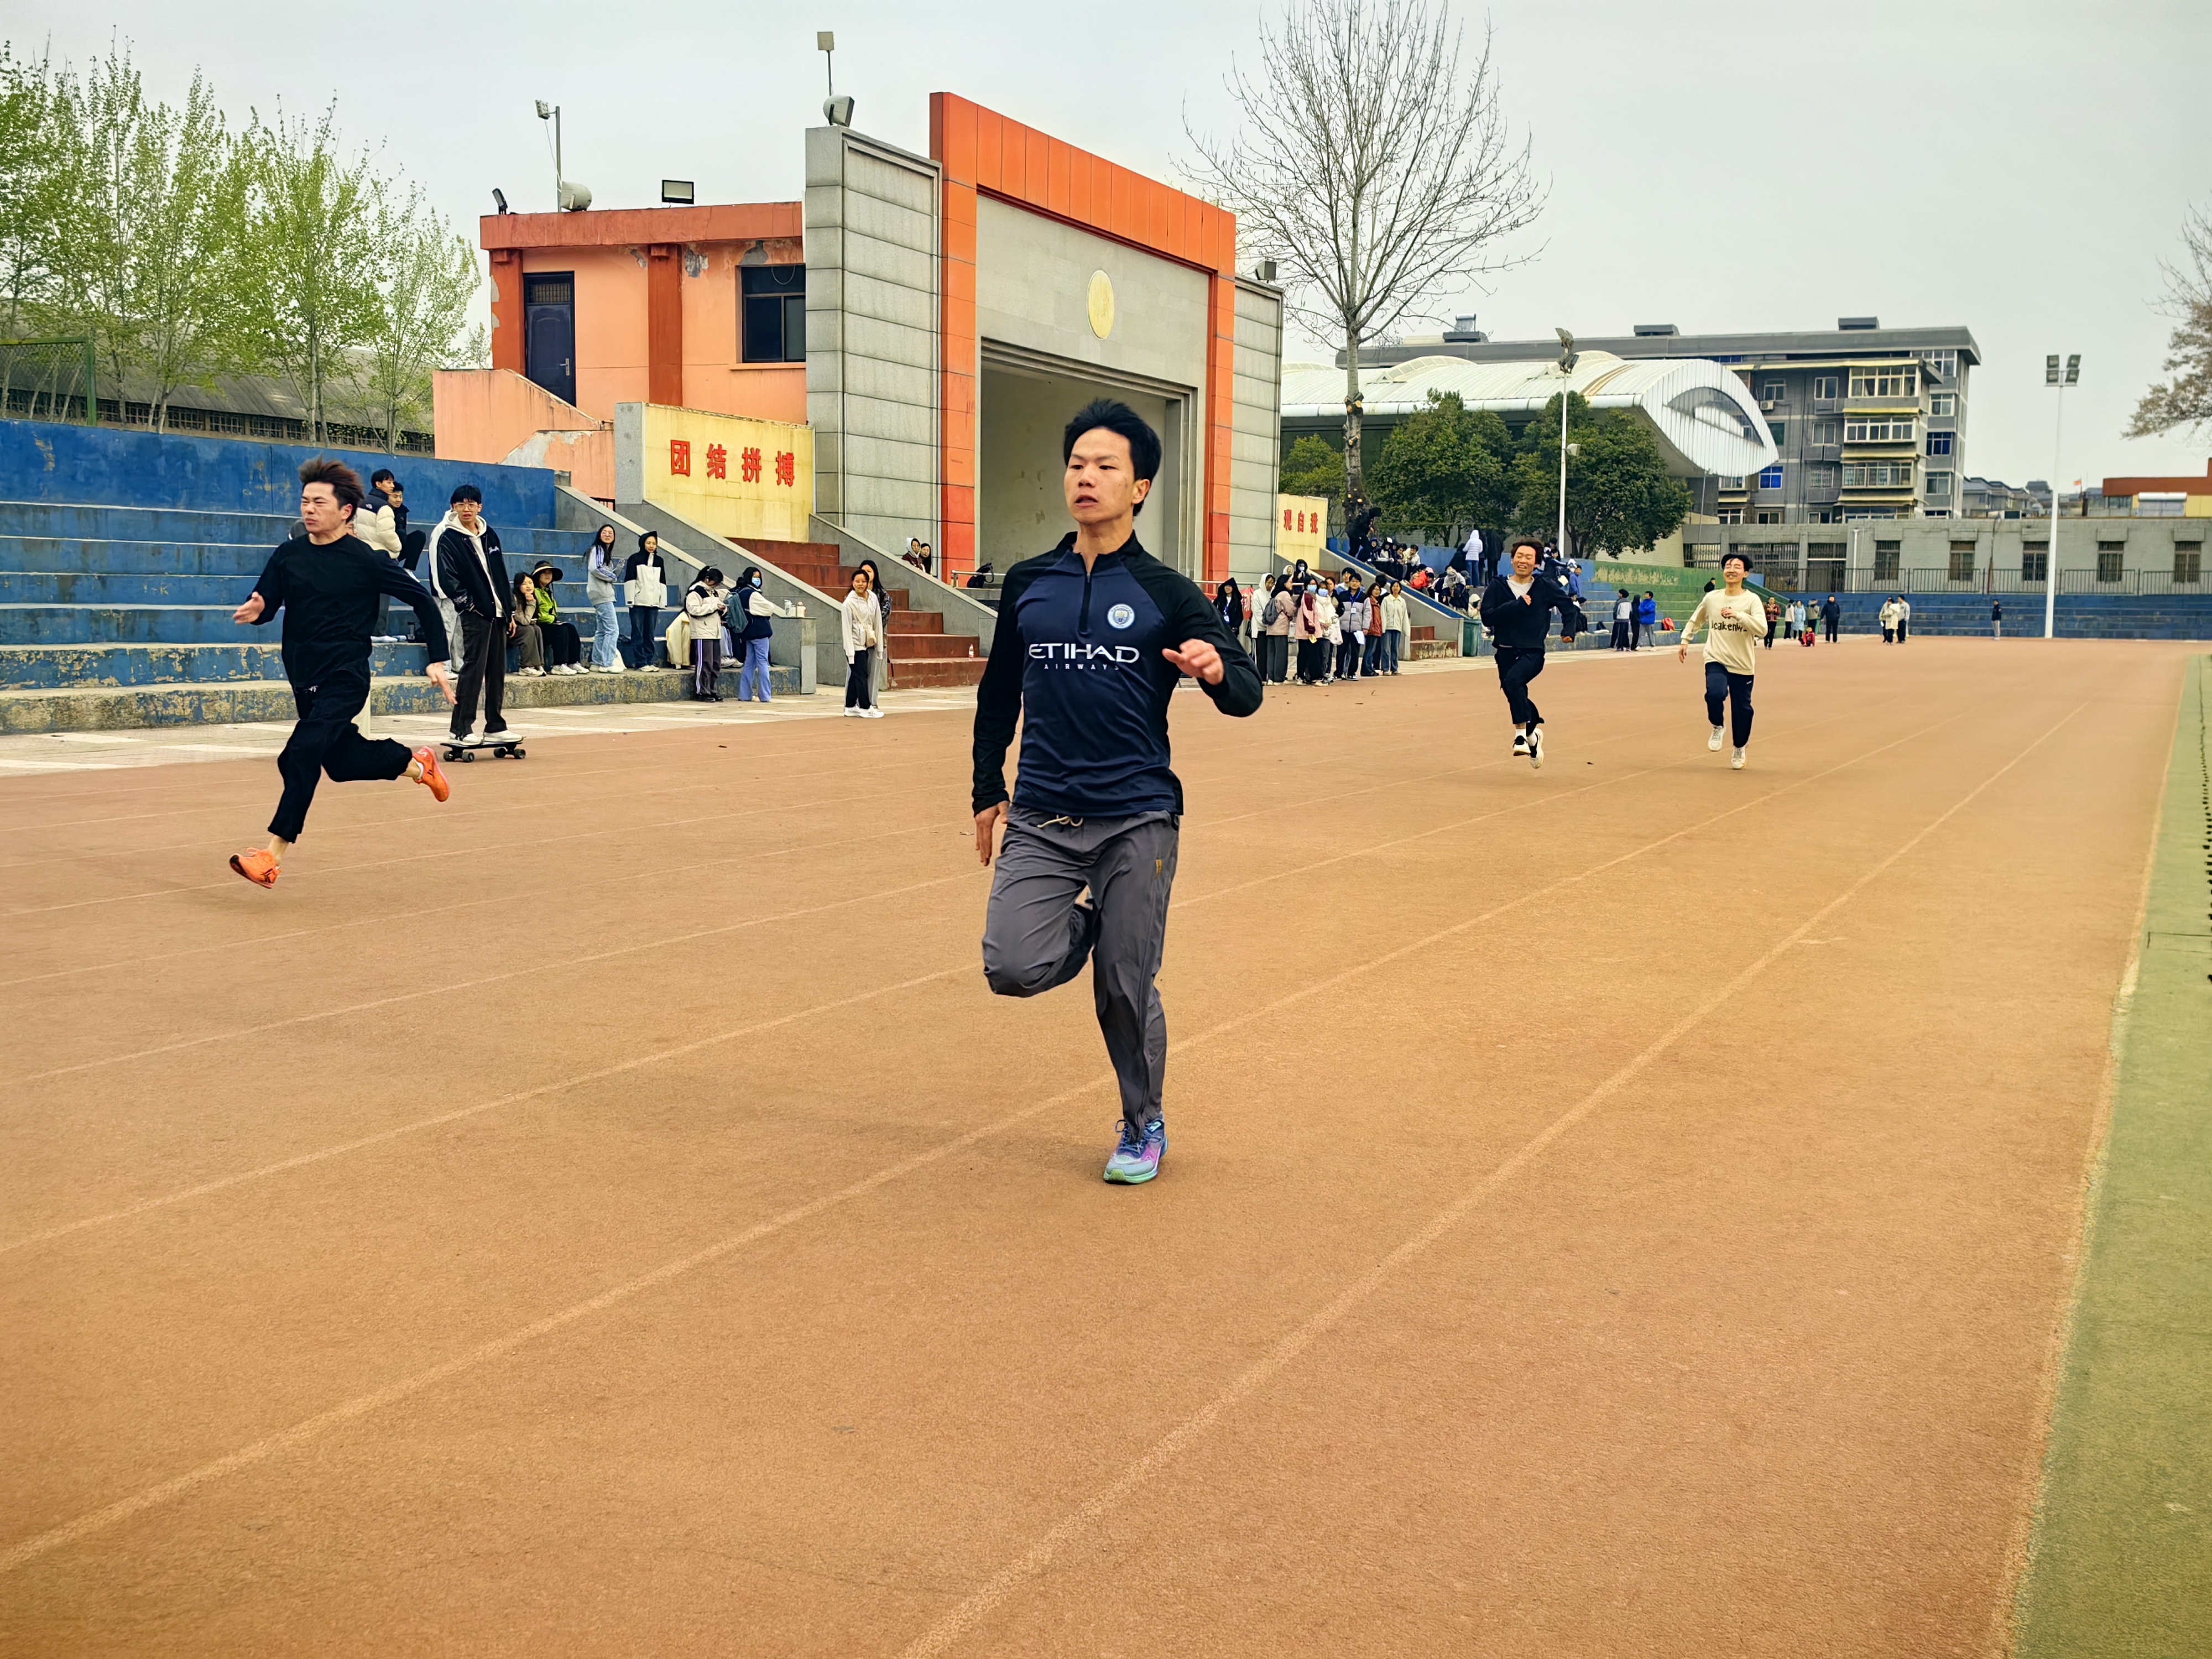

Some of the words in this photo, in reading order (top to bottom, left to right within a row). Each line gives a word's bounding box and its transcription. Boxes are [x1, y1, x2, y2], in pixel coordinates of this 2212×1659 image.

[670, 440, 795, 487] 团结拼搏
[1029, 643, 1140, 664] ETIHAD
